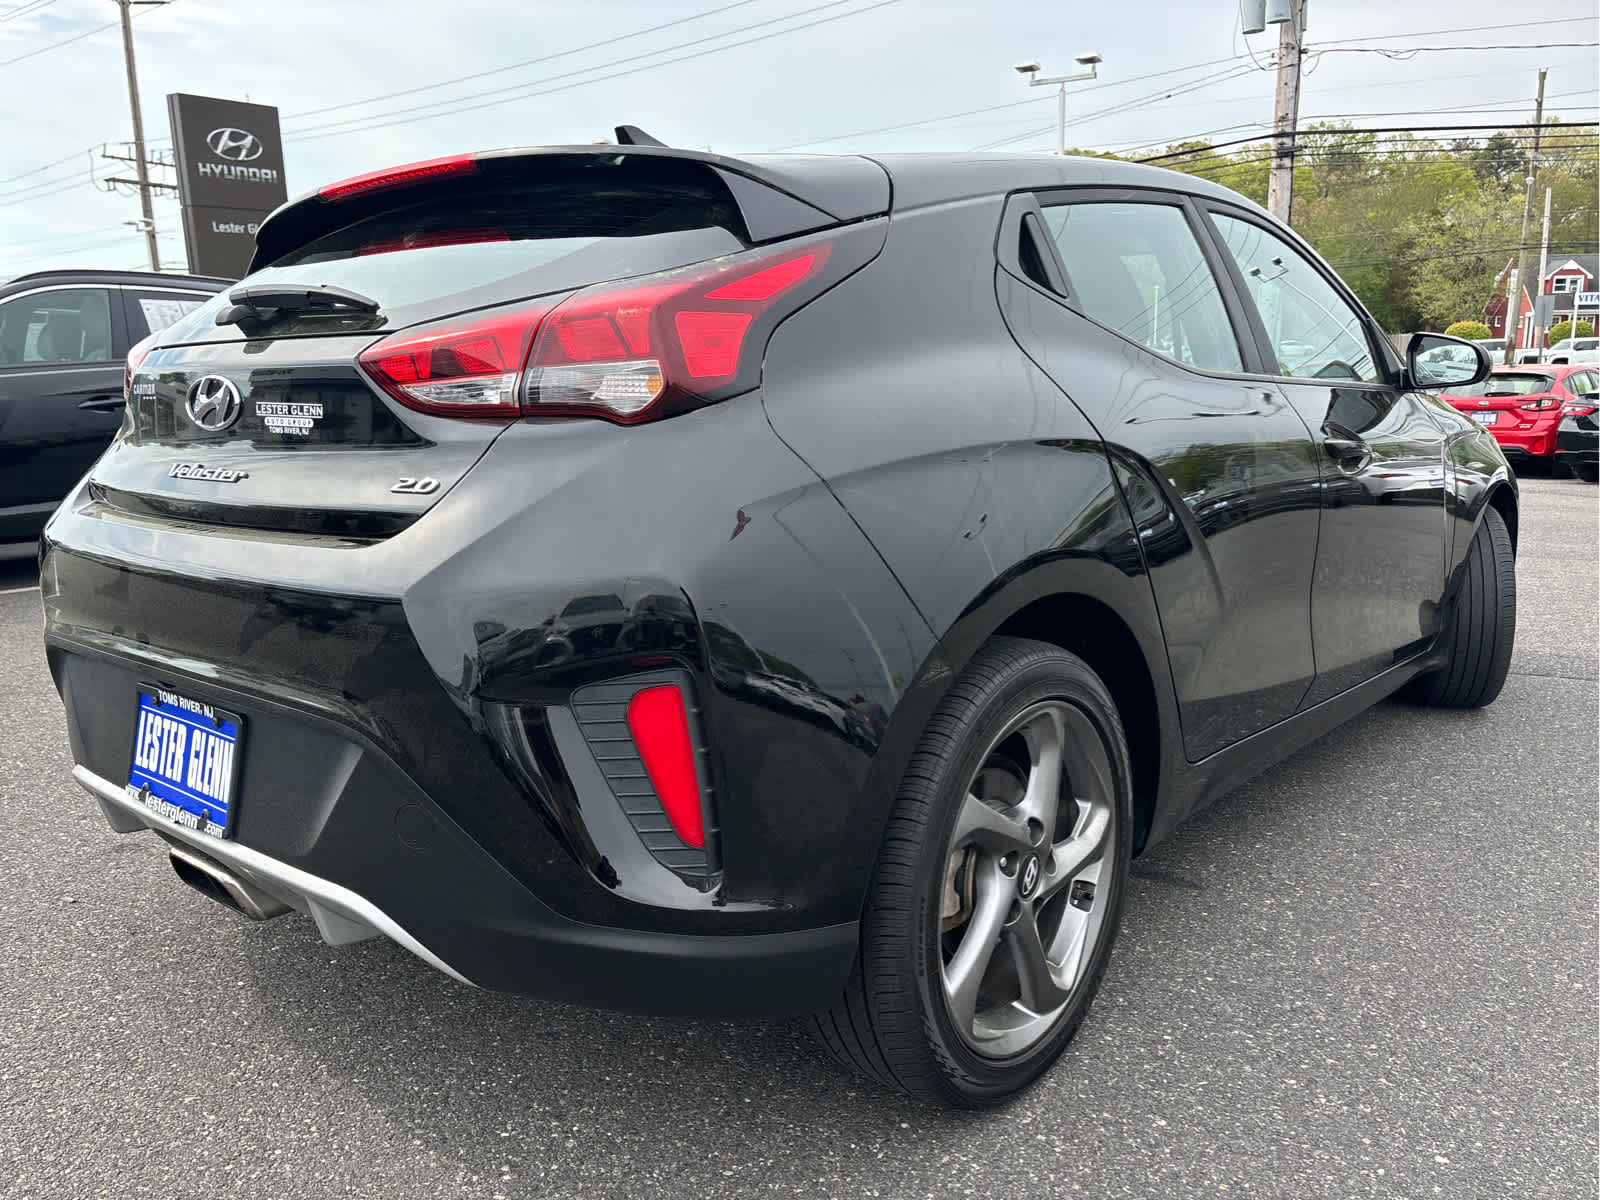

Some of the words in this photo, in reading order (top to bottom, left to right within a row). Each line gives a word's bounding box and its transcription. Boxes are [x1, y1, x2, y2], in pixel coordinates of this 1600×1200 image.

[198, 162, 278, 184] HYUNDAI
[212, 221, 245, 234] Lester
[255, 404, 288, 414] LESTER
[291, 405, 323, 416] GLENN
[302, 427, 309, 435] NJ
[168, 463, 248, 483] Veloster
[158, 689, 179, 707] TOMS
[179, 696, 203, 715] RIVER,
[203, 704, 214, 719] NJ
[135, 710, 187, 783] LESTER
[187, 729, 235, 803] GLENN
